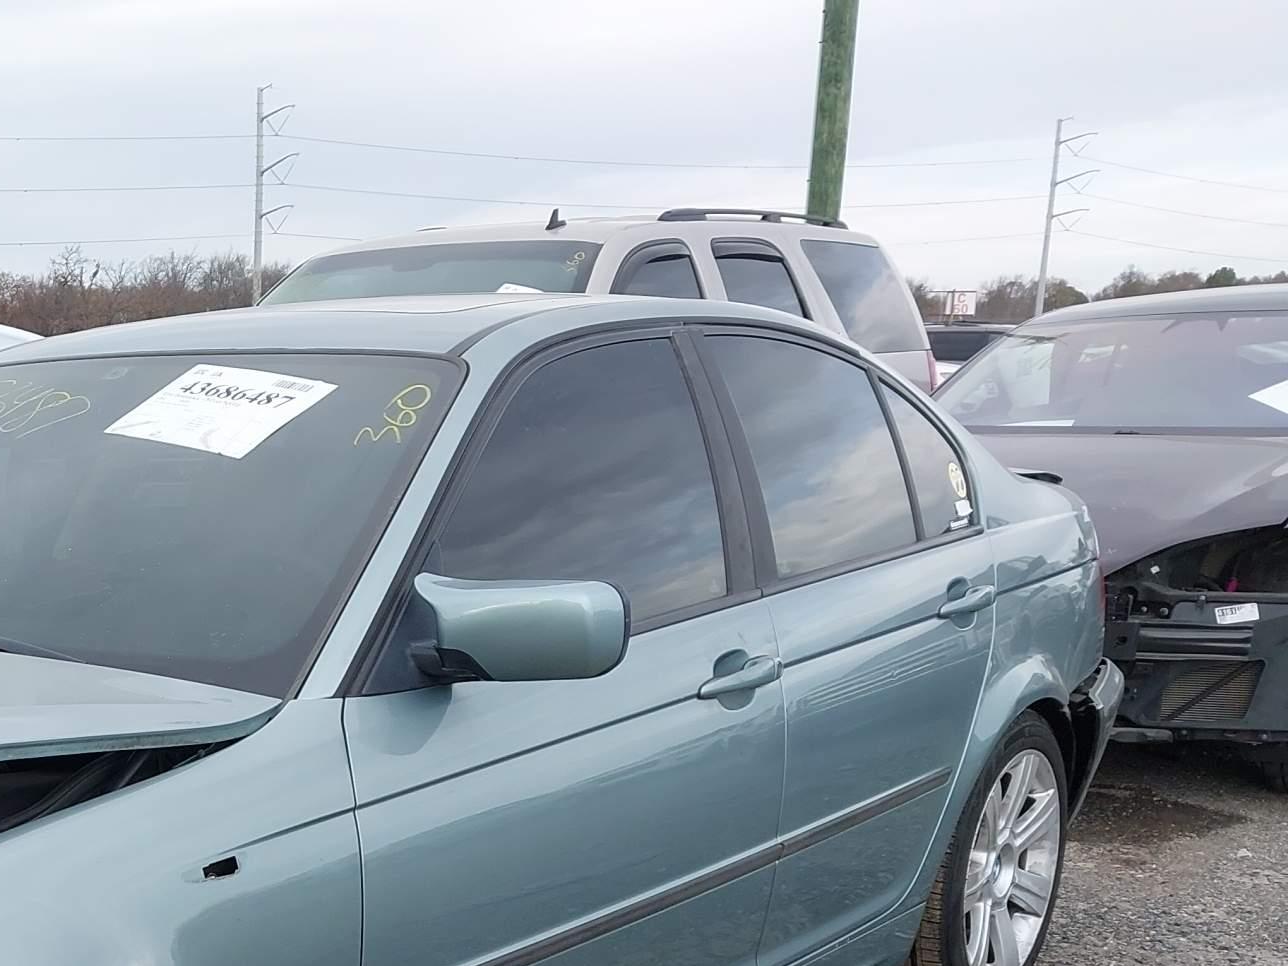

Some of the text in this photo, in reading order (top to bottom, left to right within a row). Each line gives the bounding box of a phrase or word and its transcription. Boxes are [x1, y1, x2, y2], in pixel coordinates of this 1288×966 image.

[957, 293, 967, 304] C
[180, 380, 296, 409] 43686487
[353, 384, 431, 446] 360
